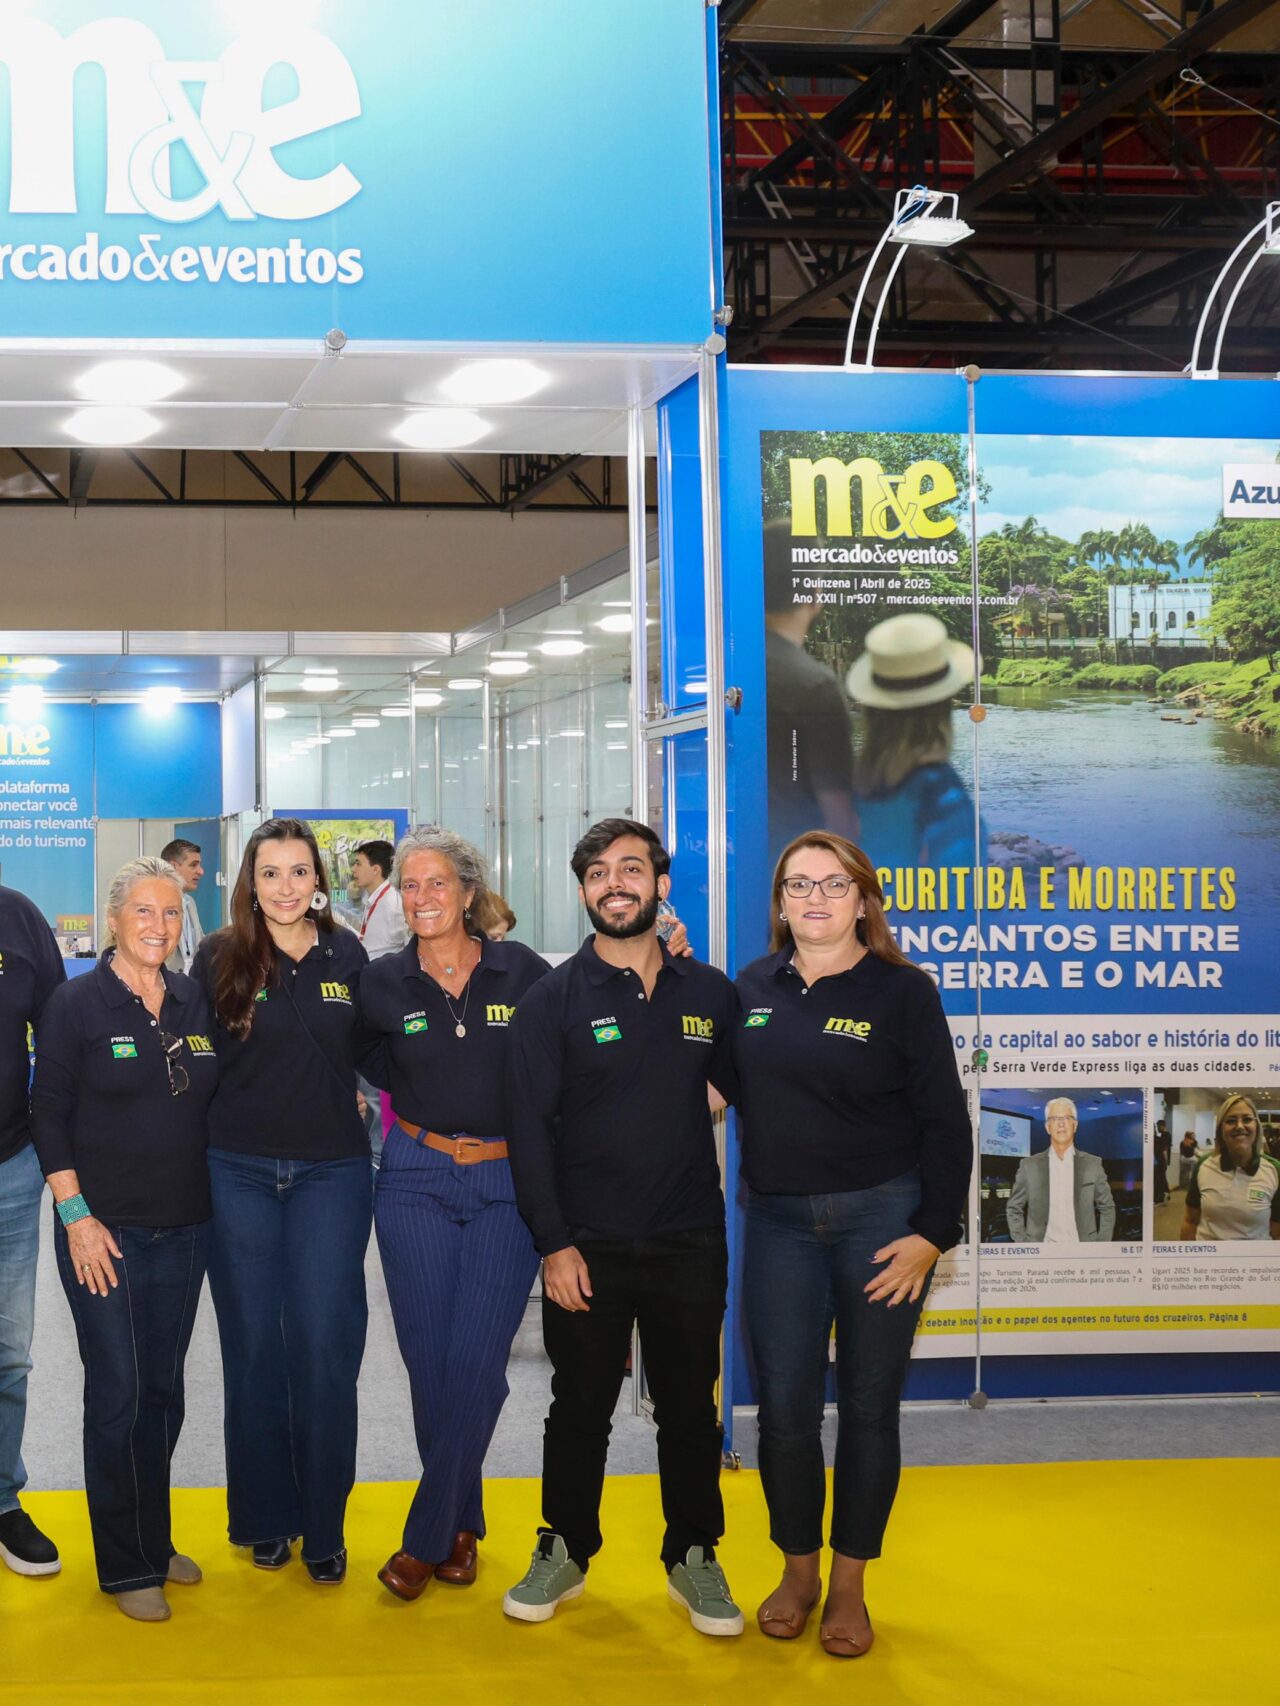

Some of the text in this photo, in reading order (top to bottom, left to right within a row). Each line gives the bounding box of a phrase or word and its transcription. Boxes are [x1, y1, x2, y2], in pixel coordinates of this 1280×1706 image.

[789, 457, 958, 540] m&e
[792, 544, 959, 564] mercado&eventos
[803, 578, 851, 589] Quinzena
[861, 578, 885, 589] Abril
[888, 579, 901, 589] de
[904, 579, 931, 590] 2025
[793, 594, 813, 604] Ano
[815, 594, 837, 604] XXII
[48, 798, 78, 812] você
[0, 818, 32, 830] mais
[34, 817, 95, 830] relevante
[16, 835, 32, 847] do
[35, 835, 86, 848] turismo
[876, 867, 1237, 912] CURITIBA E MORRETES
[64, 918, 87, 932] m&e
[1110, 925, 1239, 952] ENTRE
[918, 961, 1223, 989] SERRA E O MAR
[404, 1011, 426, 1021] PRESS
[591, 1016, 617, 1027] PRESS
[682, 1015, 714, 1038] m&e
[824, 1017, 871, 1037] m&e
[999, 1031, 1058, 1052] capital
[1065, 1035, 1085, 1048] ao
[1092, 1031, 1141, 1048] sabor
[1148, 1035, 1158, 1048] e
[1164, 1030, 1230, 1048] história
[1237, 1030, 1259, 1048] do
[963, 1062, 988, 1076] pea
[994, 1061, 1026, 1073] Serra
[1031, 1061, 1067, 1073] Verde
[1072, 1061, 1120, 1076] Express
[1125, 1060, 1147, 1075] liga
[1152, 1062, 1166, 1072] as
[1170, 1060, 1199, 1072] duas
[1204, 1060, 1256, 1072] cidades.
[1001, 1247, 1007, 1255] E
[1007, 1247, 1040, 1255] EVENTOS
[926, 1318, 957, 1327] debate
[1005, 1316, 1011, 1324] o
[1014, 1315, 1039, 1326] papel
[1042, 1315, 1058, 1324] dos
[1061, 1315, 1097, 1325] agentes
[1100, 1315, 1110, 1323] no
[1114, 1314, 1141, 1324] futuro
[1144, 1313, 1160, 1323] dos
[1162, 1311, 1206, 1323] cruzeiros.
[1210, 1310, 1238, 1323] Página
